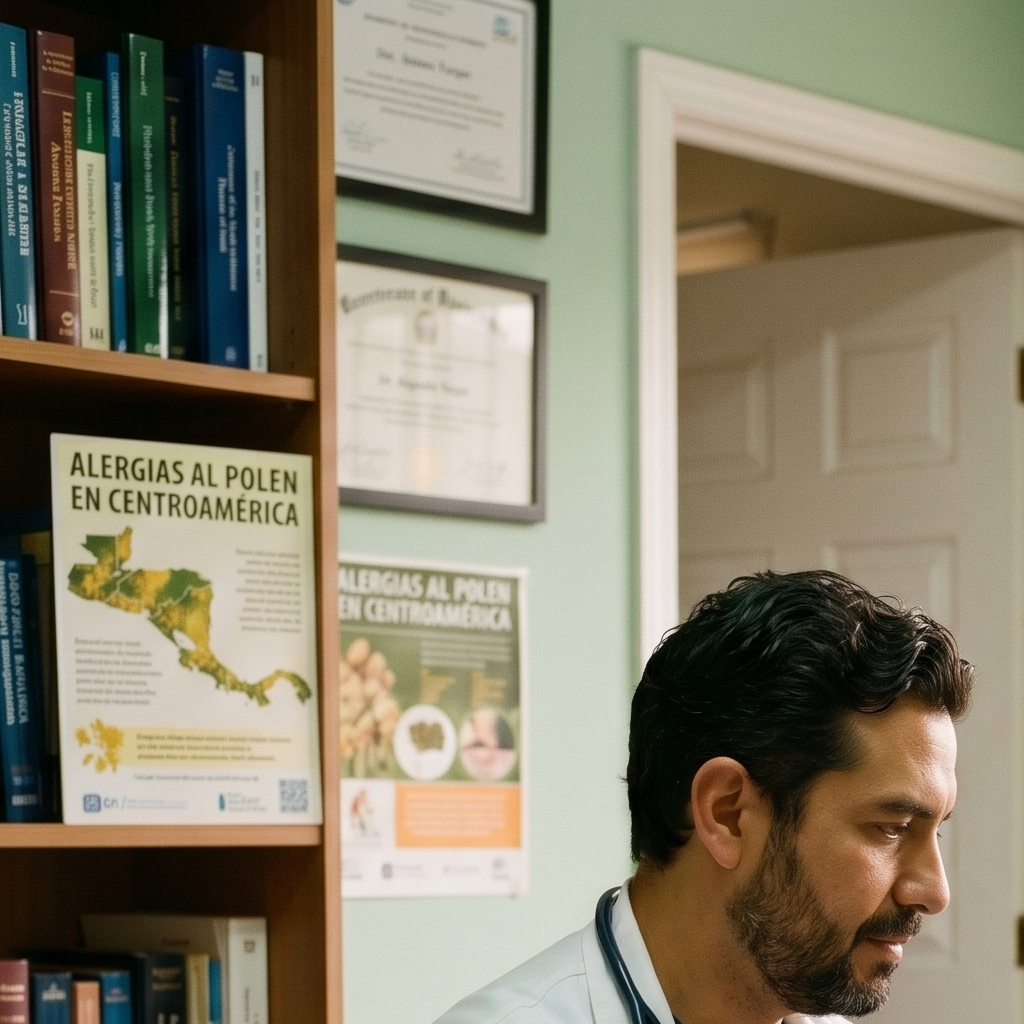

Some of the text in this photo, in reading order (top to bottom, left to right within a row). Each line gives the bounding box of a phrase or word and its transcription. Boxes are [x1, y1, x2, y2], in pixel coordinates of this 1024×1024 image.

[70, 451, 298, 494] ALERGIAS AL POLEN
[71, 485, 299, 526] EN CENTROAMÉRICA
[426, 576, 450, 600] AL
[453, 578, 511, 605] POLEN
[338, 595, 513, 631] EN CENTROAMÉRICA
